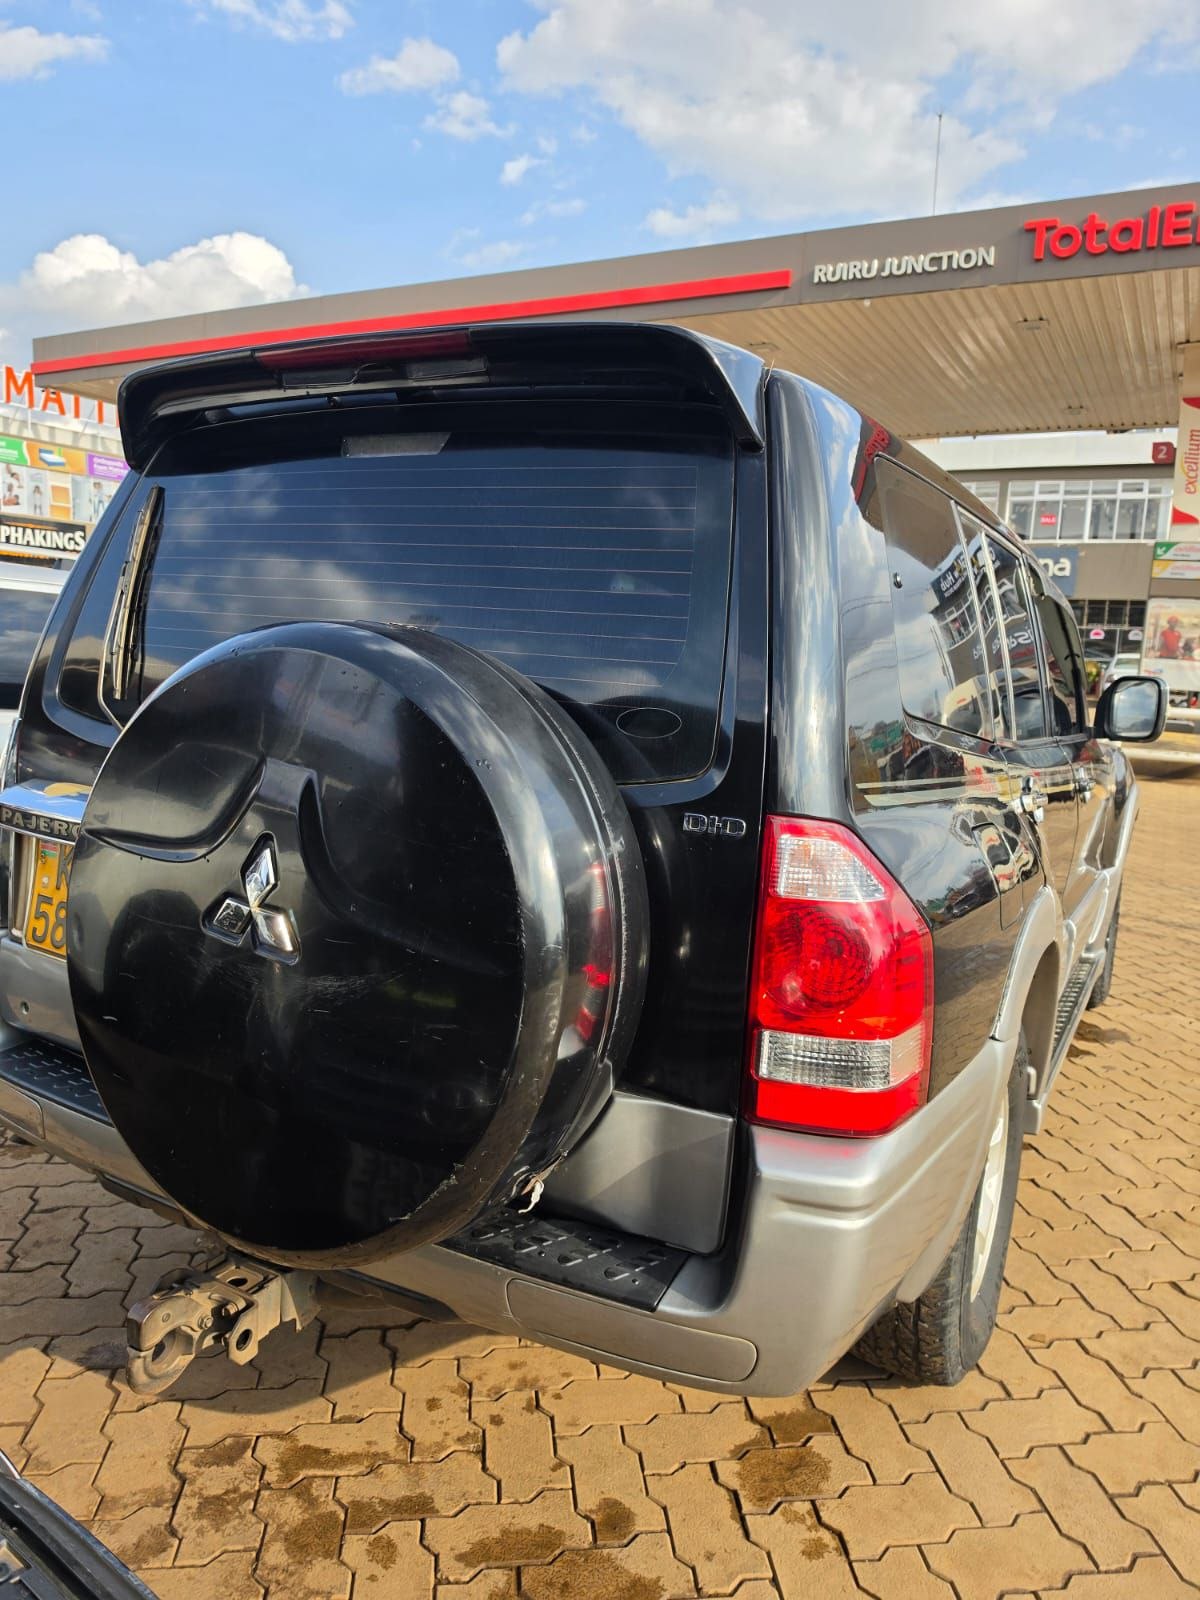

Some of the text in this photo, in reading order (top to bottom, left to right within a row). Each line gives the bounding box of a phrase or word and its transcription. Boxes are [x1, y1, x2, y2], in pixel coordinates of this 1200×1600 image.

[1023, 202, 1200, 260] TotalE
[813, 245, 996, 284] RUIRU JUNCTION
[1157, 446, 1168, 459] 2
[0, 525, 85, 551] PHAKINGS
[31, 895, 67, 950] 58
